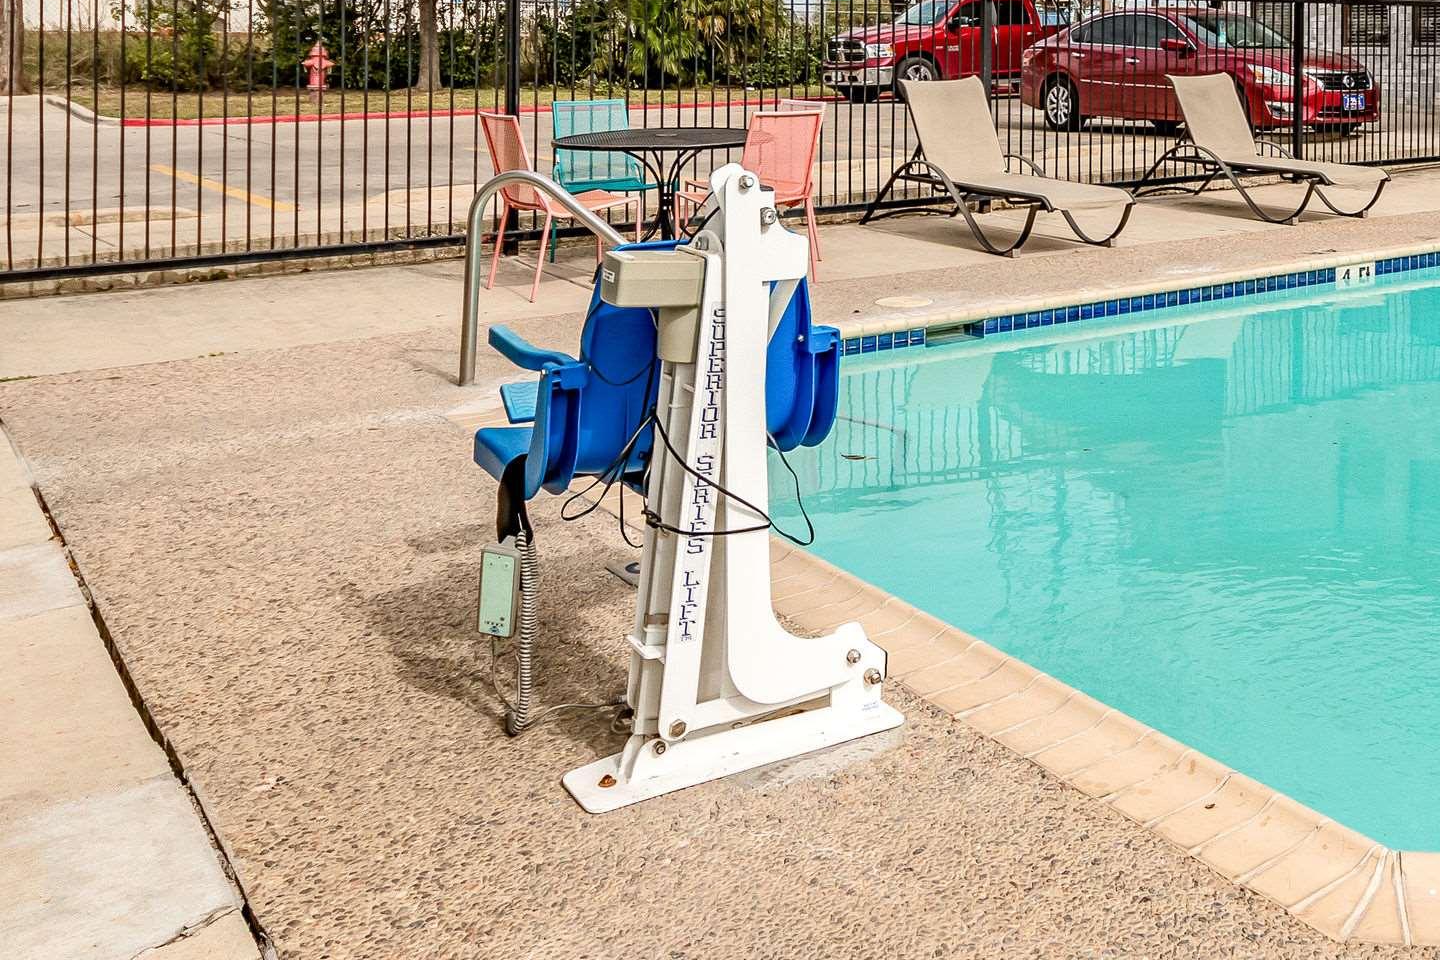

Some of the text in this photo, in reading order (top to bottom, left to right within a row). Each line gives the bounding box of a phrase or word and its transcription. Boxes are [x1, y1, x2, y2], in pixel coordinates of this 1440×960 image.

[700, 308, 726, 439] SUPERIOR
[686, 453, 715, 554] SERIES
[678, 570, 700, 637] LIFT
